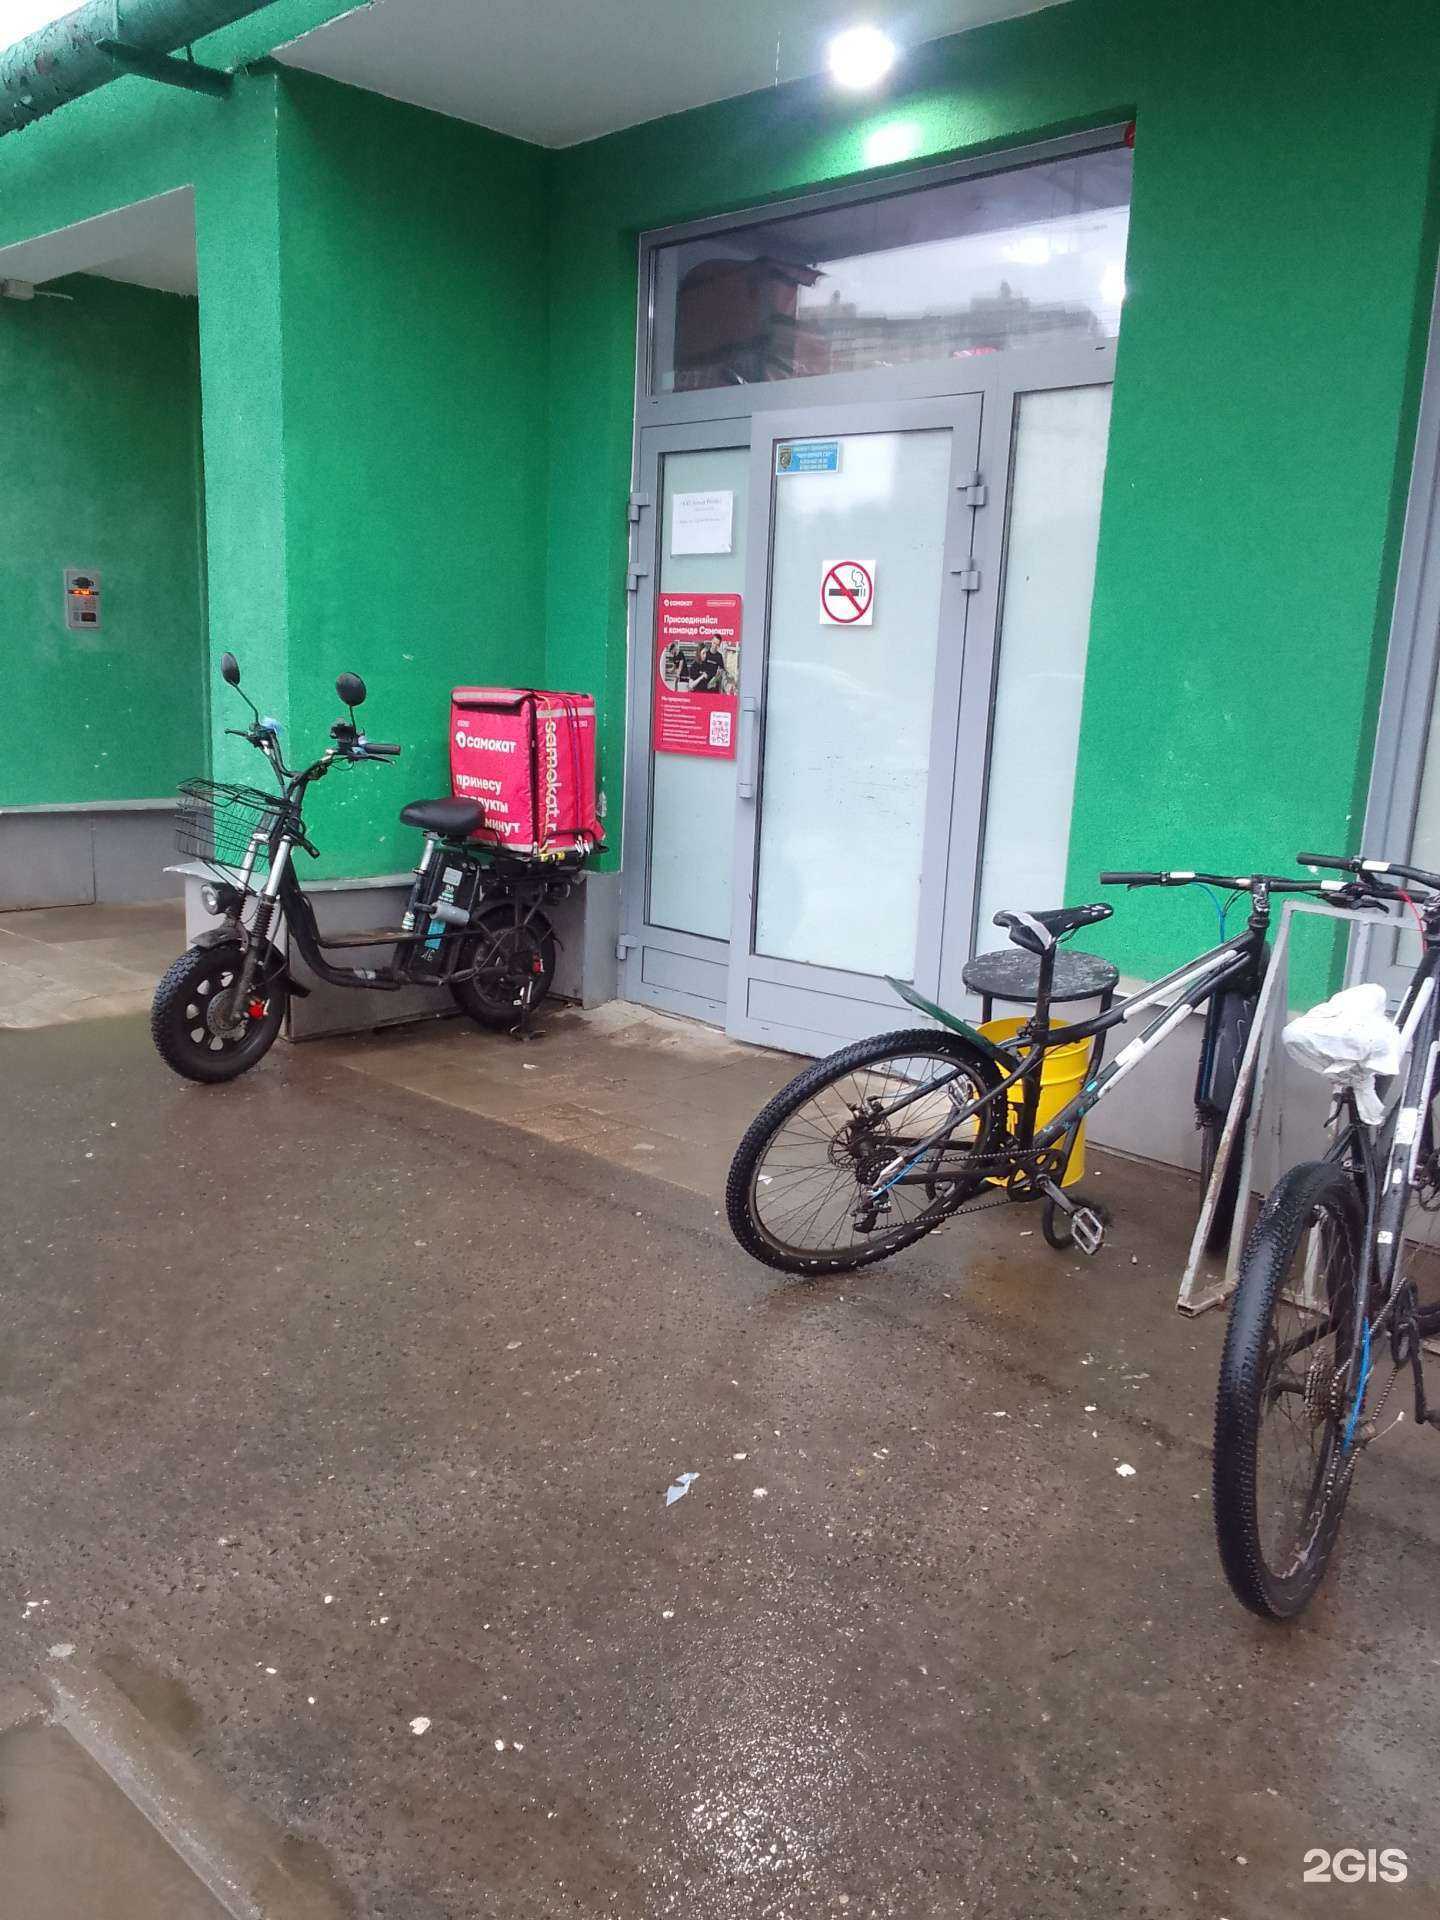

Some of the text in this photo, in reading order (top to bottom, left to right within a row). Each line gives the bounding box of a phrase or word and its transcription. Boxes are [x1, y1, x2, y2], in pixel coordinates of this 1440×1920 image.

[663, 614, 718, 625] Присоединяйся
[669, 627, 698, 635] команде
[699, 626, 734, 635] Самоката
[466, 736, 517, 753] самокат
[456, 774, 502, 796] принесу
[545, 721, 561, 844] samokat.r
[484, 818, 520, 836] минут
